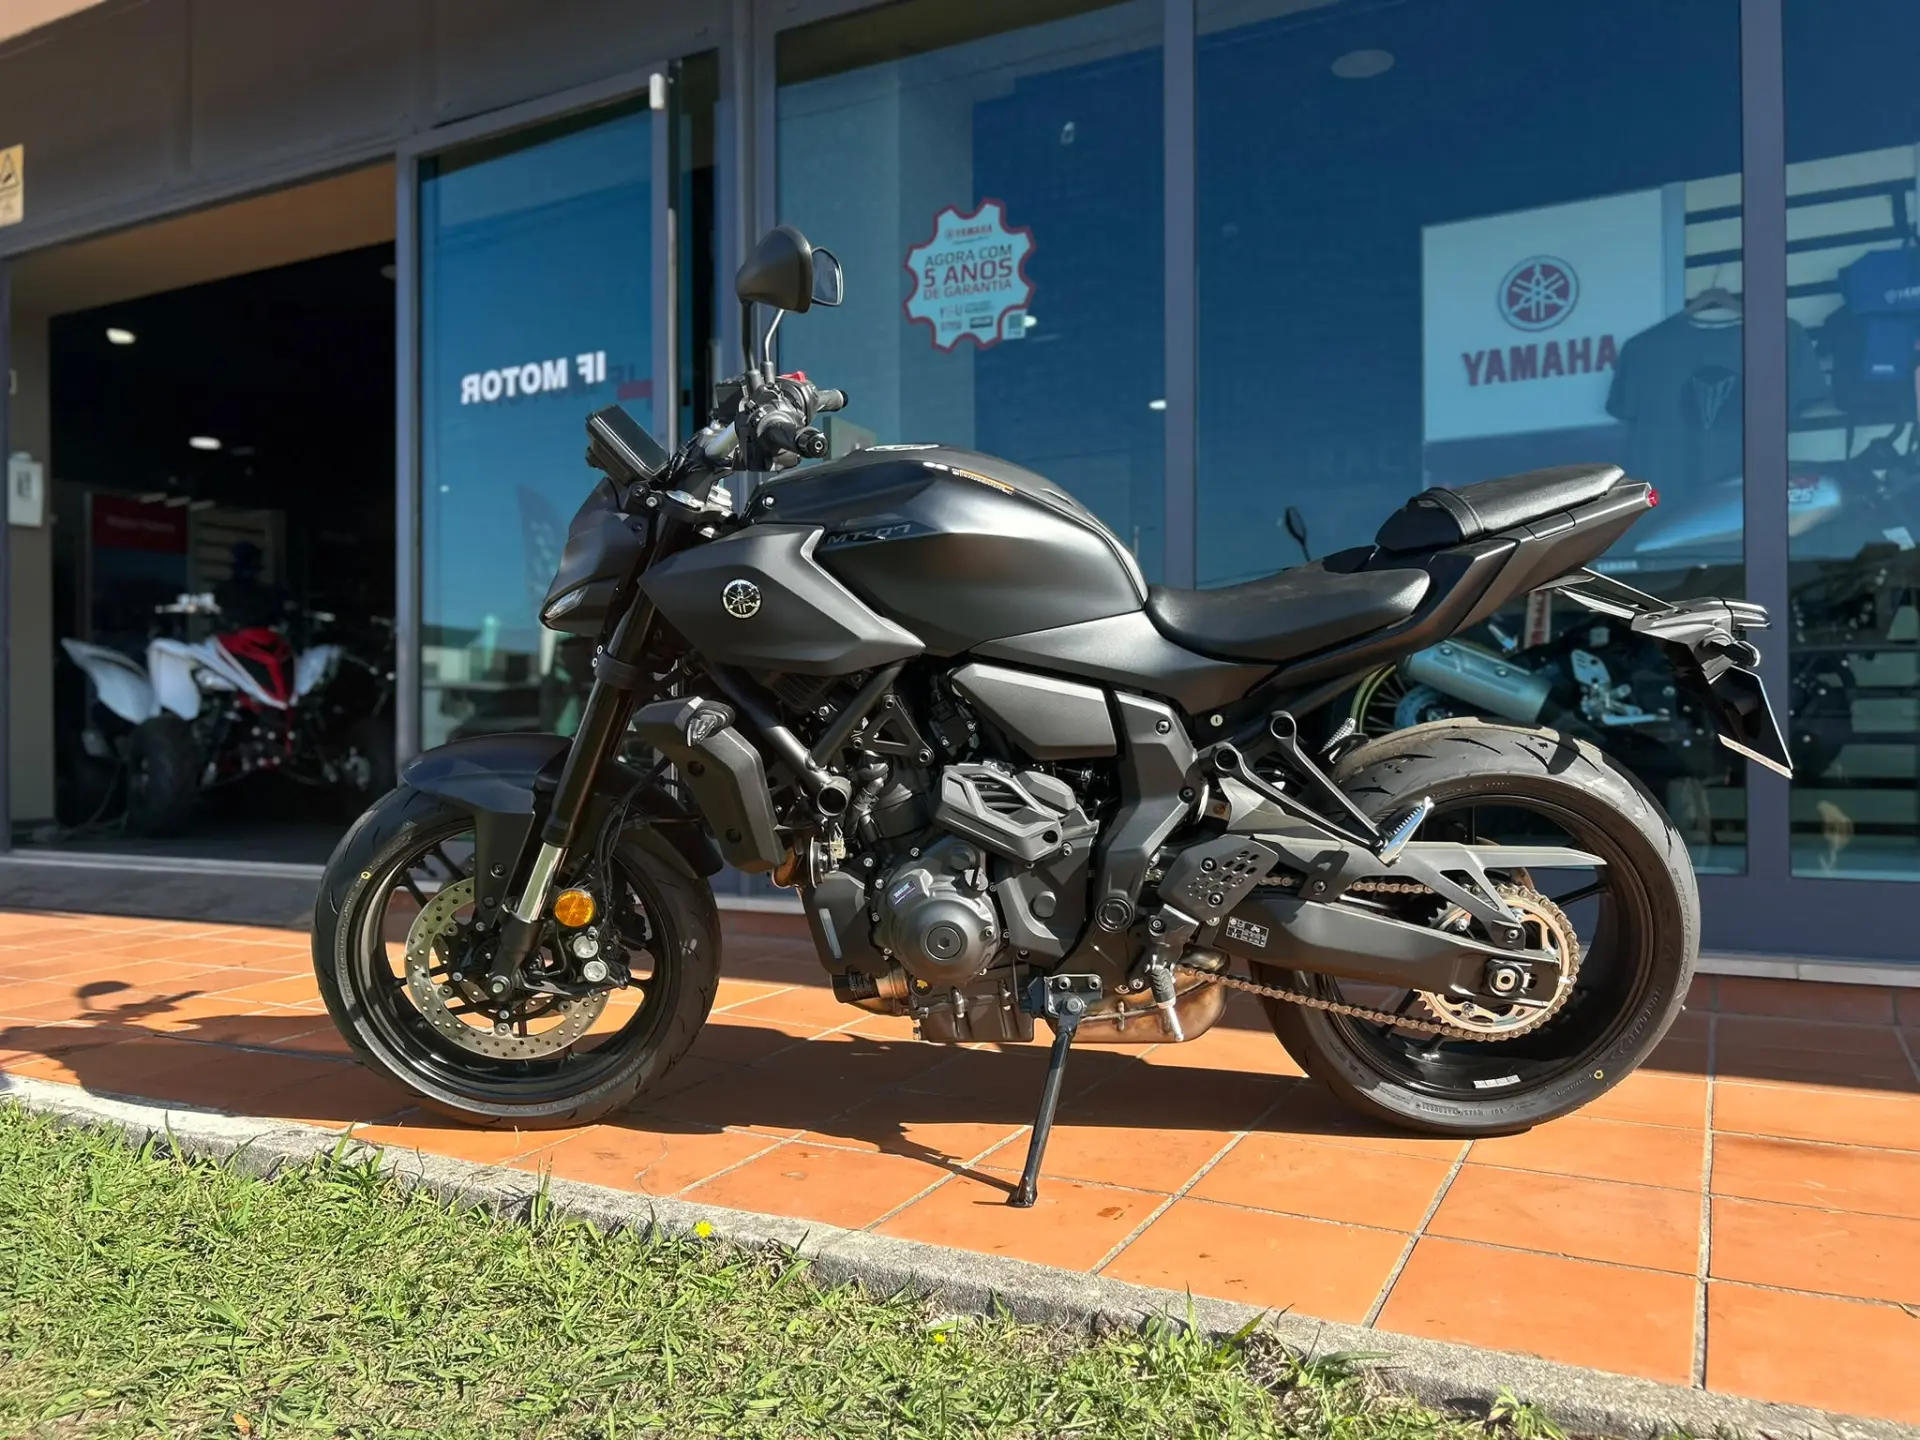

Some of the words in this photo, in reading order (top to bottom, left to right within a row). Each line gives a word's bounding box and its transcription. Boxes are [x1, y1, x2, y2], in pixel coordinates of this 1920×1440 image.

[925, 249, 975, 267] AGORA
[979, 244, 1012, 259] COM
[924, 268, 936, 288] 5
[943, 257, 1013, 286] ANOS
[924, 287, 940, 301] DE
[944, 279, 1013, 299] GARANTIA
[1461, 334, 1619, 387] YAMAHA
[827, 523, 912, 545] MT-07
